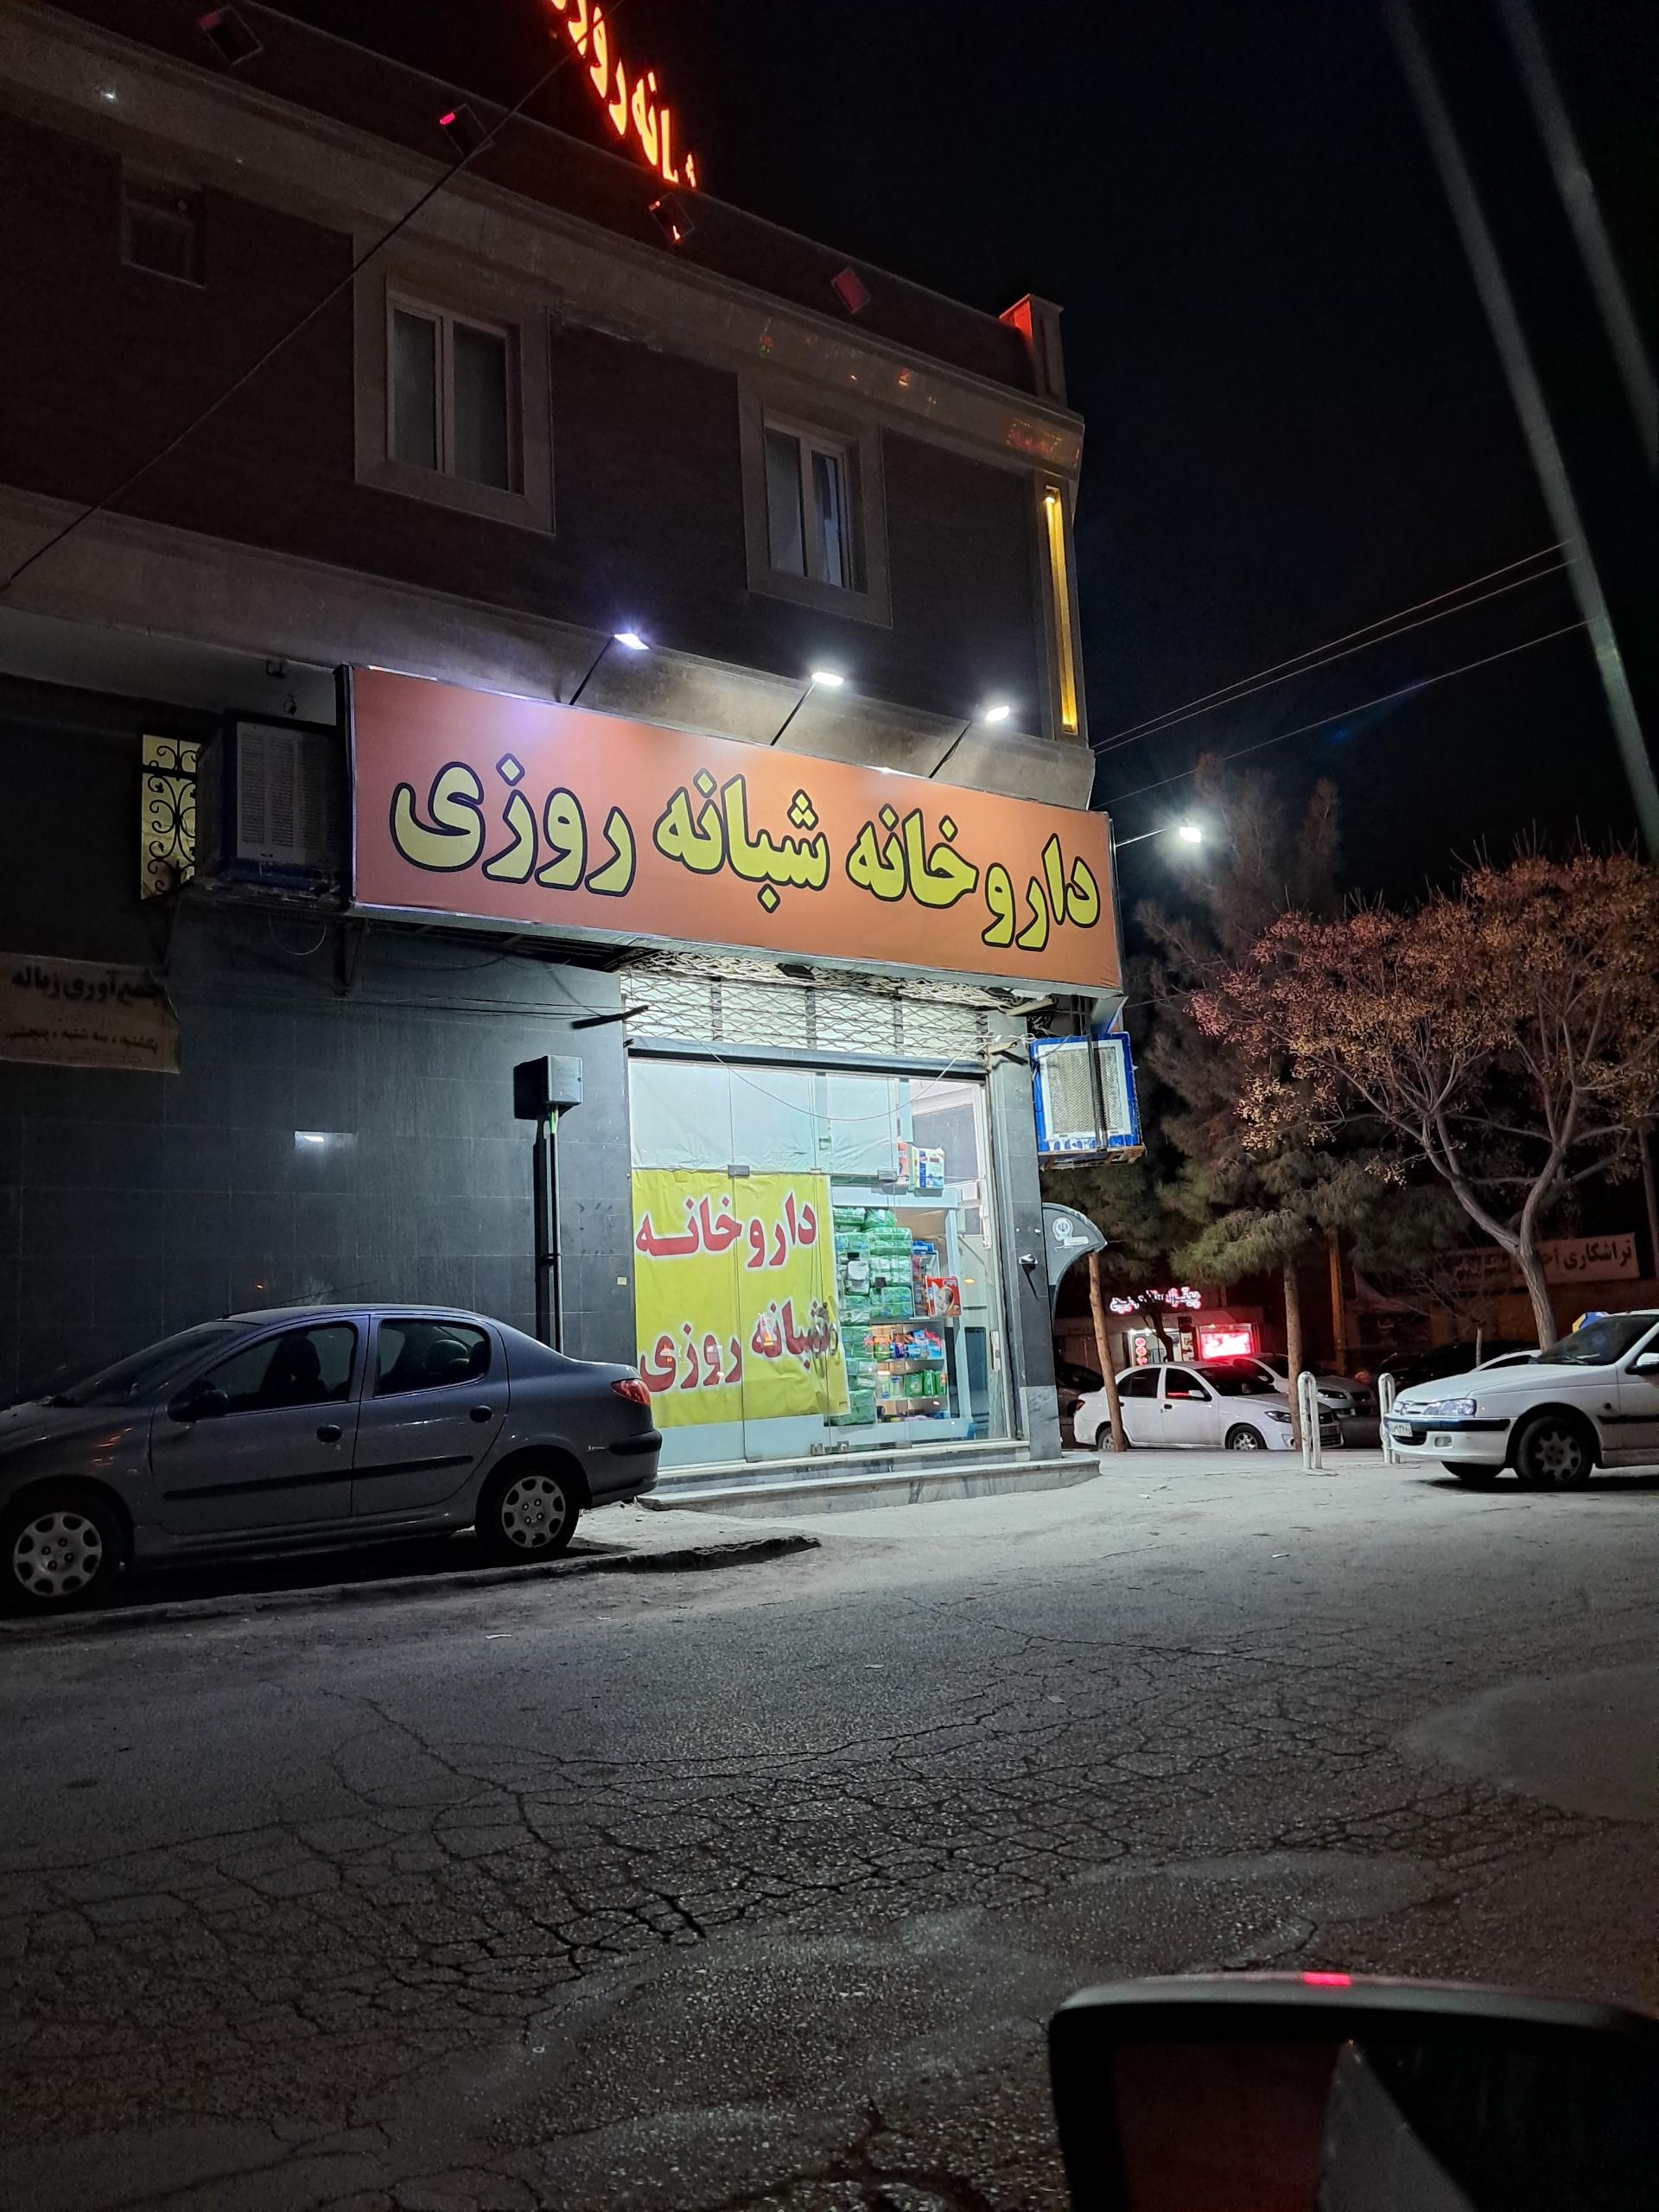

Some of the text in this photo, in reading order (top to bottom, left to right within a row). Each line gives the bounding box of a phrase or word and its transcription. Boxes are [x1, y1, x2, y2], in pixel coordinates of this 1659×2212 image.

[390, 753, 1101, 952] داروخانه شبانه روزی
[636, 1192, 817, 1268] داروخانه
[639, 1323, 742, 1393] روزی
